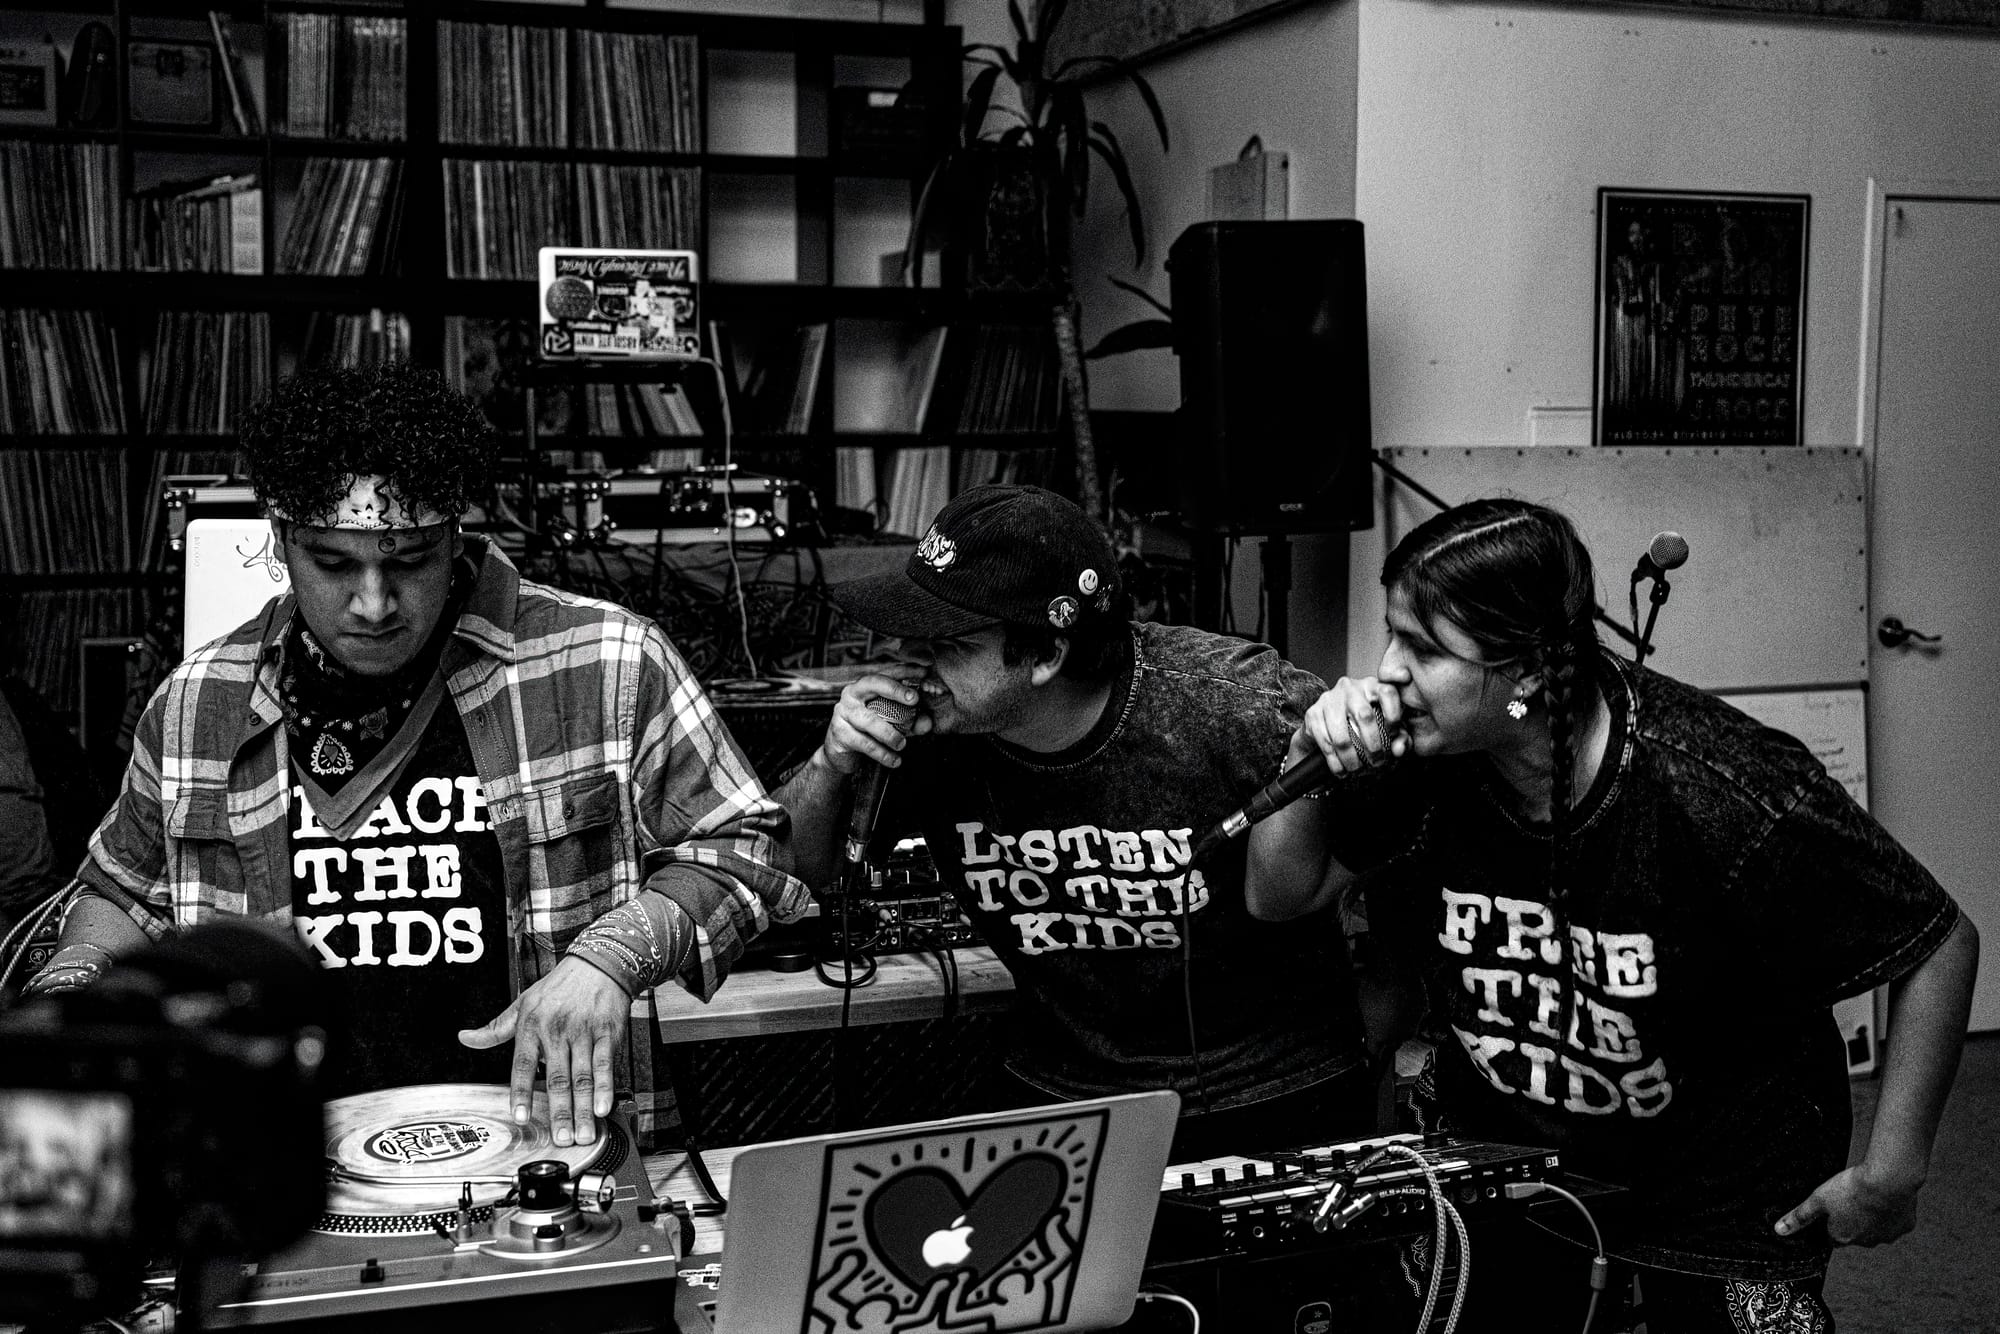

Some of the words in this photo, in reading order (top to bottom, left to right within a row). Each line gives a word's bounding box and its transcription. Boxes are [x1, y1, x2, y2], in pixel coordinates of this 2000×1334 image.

[1690, 334, 1791, 363] ROCK
[292, 776, 494, 839] EACH
[294, 844, 462, 905] THE
[955, 821, 1193, 874] LISTEN
[964, 868, 1051, 911] TO
[1065, 869, 1210, 917] THE
[294, 906, 484, 969] KIDS
[1010, 912, 1182, 955] KIDS
[1438, 887, 1658, 999] FREE
[1462, 966, 1643, 1063] THE
[1451, 1023, 1673, 1118] KIDS
